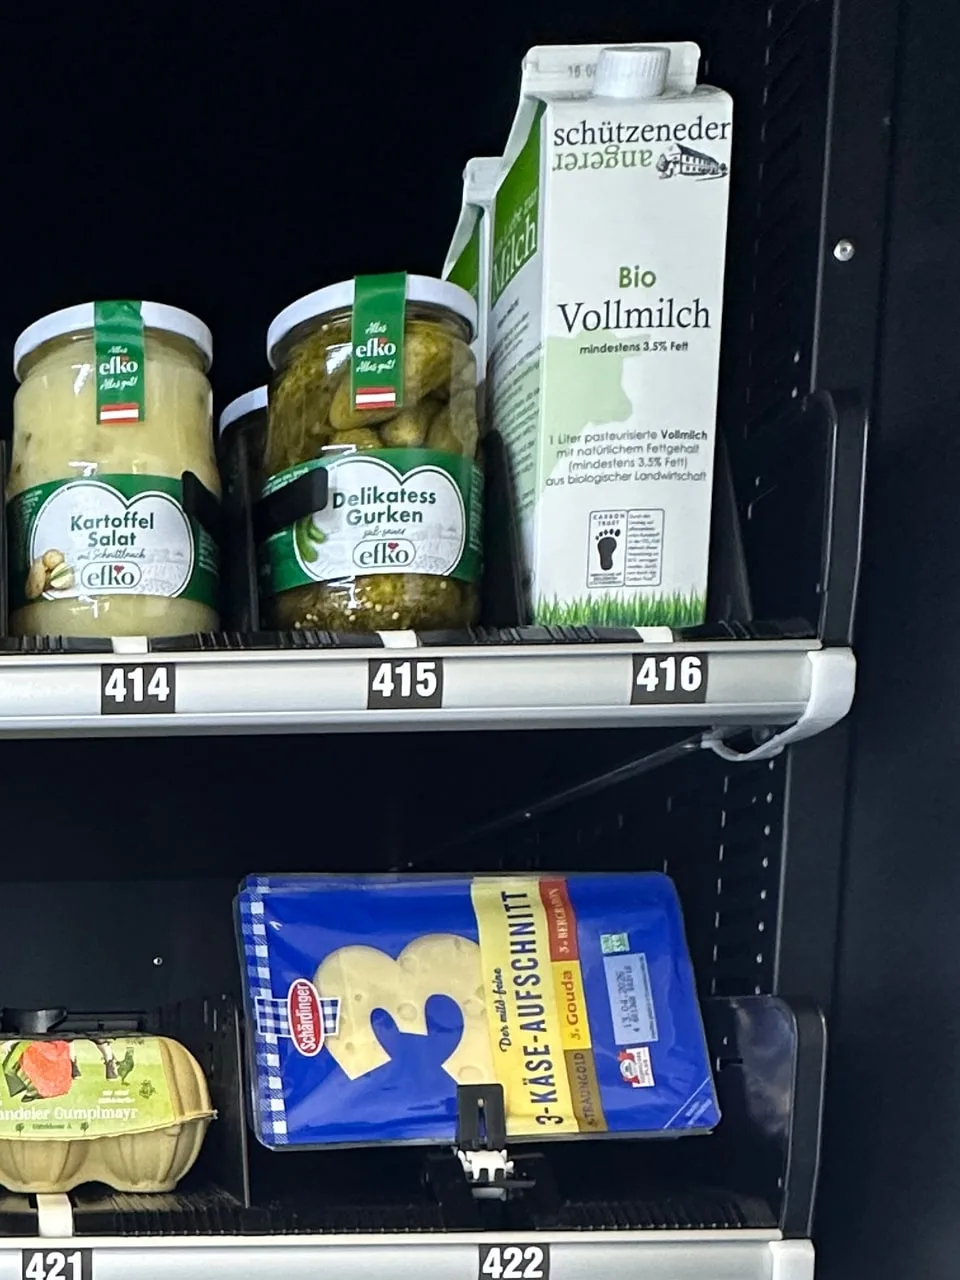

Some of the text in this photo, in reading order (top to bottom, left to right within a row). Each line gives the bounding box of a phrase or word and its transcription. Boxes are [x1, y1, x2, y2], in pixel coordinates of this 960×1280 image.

[553, 115, 731, 146] schützeneder
[552, 144, 653, 172] angerer
[619, 265, 657, 289] Bio
[557, 297, 711, 333] Vollmilch
[356, 337, 396, 357] efko
[580, 342, 640, 355] mindestens
[670, 341, 688, 350] Fett
[99, 356, 138, 375] efko
[558, 430, 707, 445] Liter pasteurisierte Vollmilch
[556, 443, 699, 459] mit natürlichem Fettgehalt
[569, 459, 635, 472] (mindestens
[665, 457, 688, 469] Fett)
[546, 470, 706, 486] aus biologischer Landwirtschaft
[332, 485, 436, 509] Delikatess
[71, 511, 154, 531] Kartoffel
[346, 505, 423, 526] Gurken
[88, 530, 137, 547] Salat
[359, 541, 409, 565] efko
[87, 565, 134, 586] efko
[105, 668, 169, 702] 414
[372, 662, 436, 696] 415
[637, 657, 701, 691] 416
[500, 891, 564, 1125] 3-KÄSE-AUFSCHNITT
[560, 970, 579, 1026] Gouda
[295, 984, 316, 1050] Schärdinger
[498, 1025, 512, 1053] Der
[54, 1106, 138, 1121] Gumplmayr
[483, 1246, 543, 1278] 422
